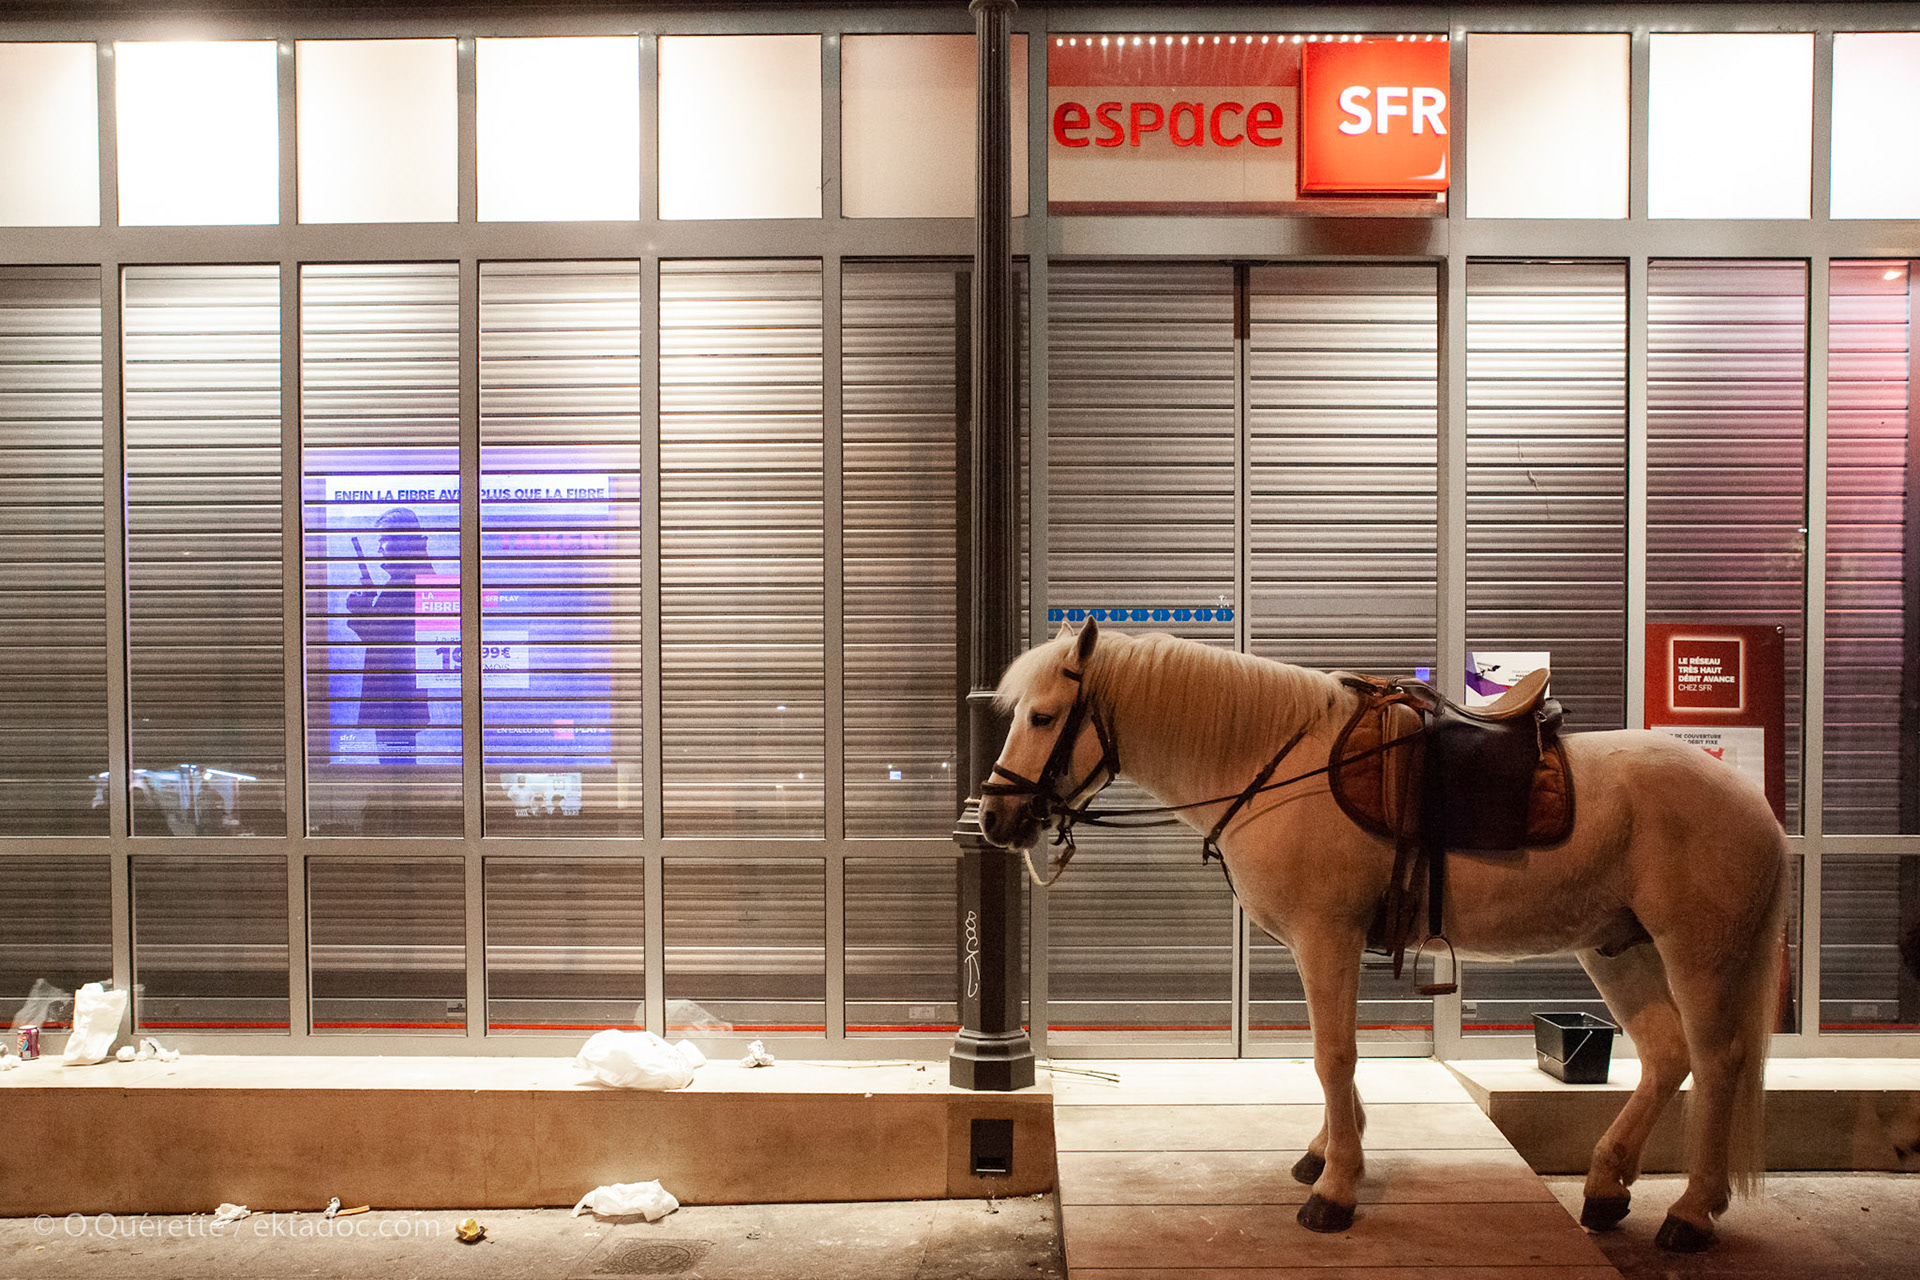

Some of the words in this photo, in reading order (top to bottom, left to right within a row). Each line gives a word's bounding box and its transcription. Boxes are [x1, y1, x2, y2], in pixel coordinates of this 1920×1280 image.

[1338, 86, 1447, 135] SFR
[1053, 102, 1284, 147] espace
[335, 490, 373, 501] ENFIN
[377, 490, 394, 501] LA
[398, 489, 435, 501] FIBRE
[515, 488, 542, 500] QUE
[546, 488, 563, 500] LA
[567, 488, 605, 500] FIBRE
[421, 592, 434, 600] LA
[422, 602, 460, 612] FIBRE
[1689, 656, 1720, 665] RÉSEAU
[1678, 665, 1698, 673] TRÈS
[1678, 674, 1701, 682] DÉBIT
[1703, 675, 1735, 683] AVANCE
